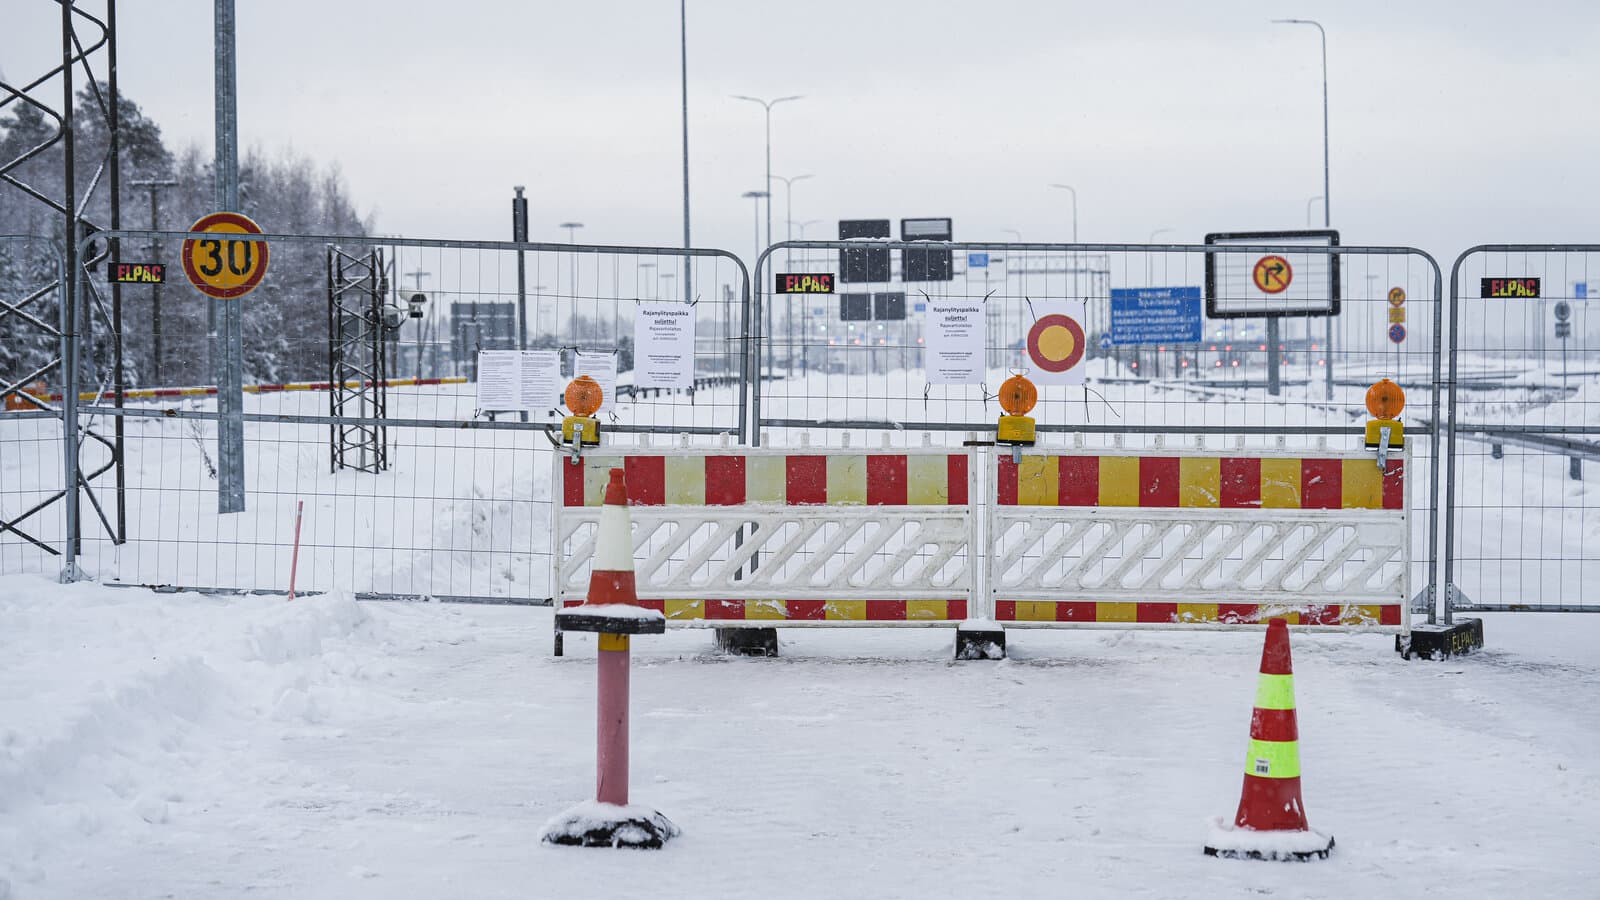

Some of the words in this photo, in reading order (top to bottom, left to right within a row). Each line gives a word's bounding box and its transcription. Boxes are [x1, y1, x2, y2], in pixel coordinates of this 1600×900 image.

[200, 237, 252, 277] 30
[117, 264, 162, 283] ELPAC
[785, 275, 831, 292] ELPAC
[1491, 279, 1537, 297] ELPAC
[642, 309, 689, 317] Rajanylityspaikka
[933, 306, 980, 314] Rajanylityspaikka
